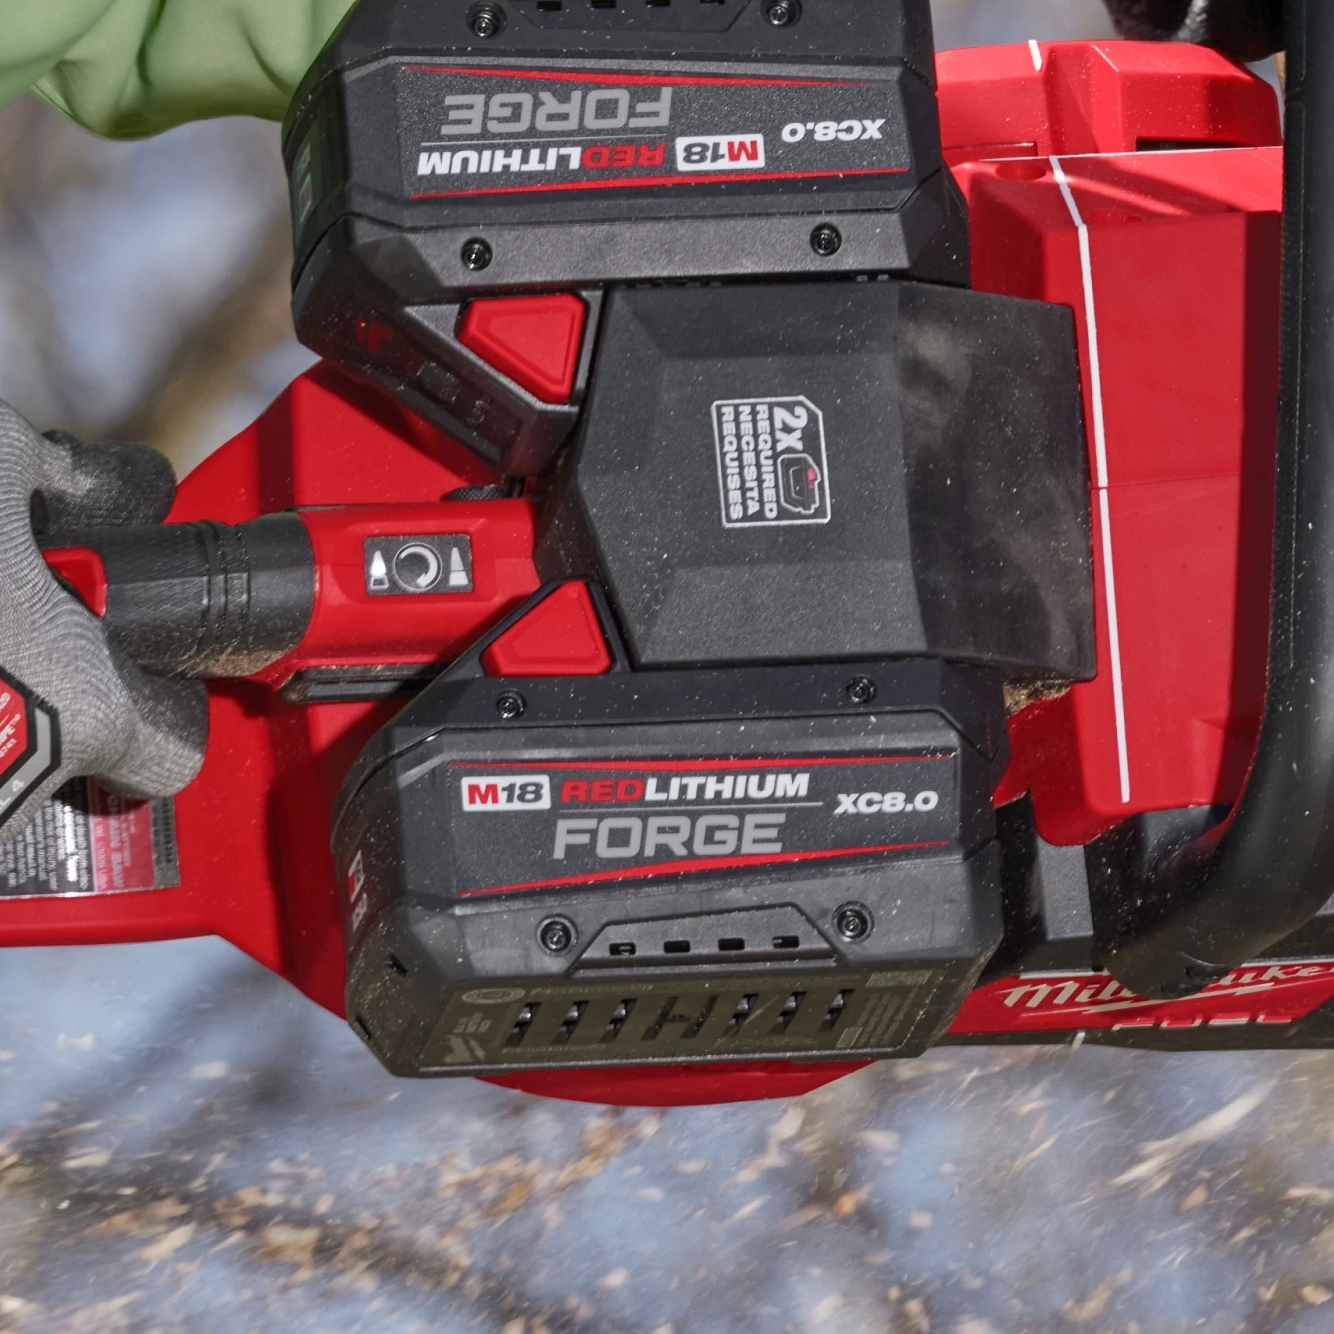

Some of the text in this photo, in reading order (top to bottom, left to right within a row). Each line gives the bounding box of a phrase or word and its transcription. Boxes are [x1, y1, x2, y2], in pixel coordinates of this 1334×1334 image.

[440, 86, 672, 135] FORGE
[781, 118, 886, 142] XC8.0
[417, 138, 760, 176] M18 REDLITHIUM
[720, 405, 744, 521] REQUISES
[738, 404, 761, 516] NECESITA
[755, 403, 778, 520] REQUIRED
[12, 779, 25, 792] 4
[467, 773, 809, 806] M18 REDLITHIUM
[834, 790, 938, 814] XC8.0
[552, 812, 787, 859] FORGE
